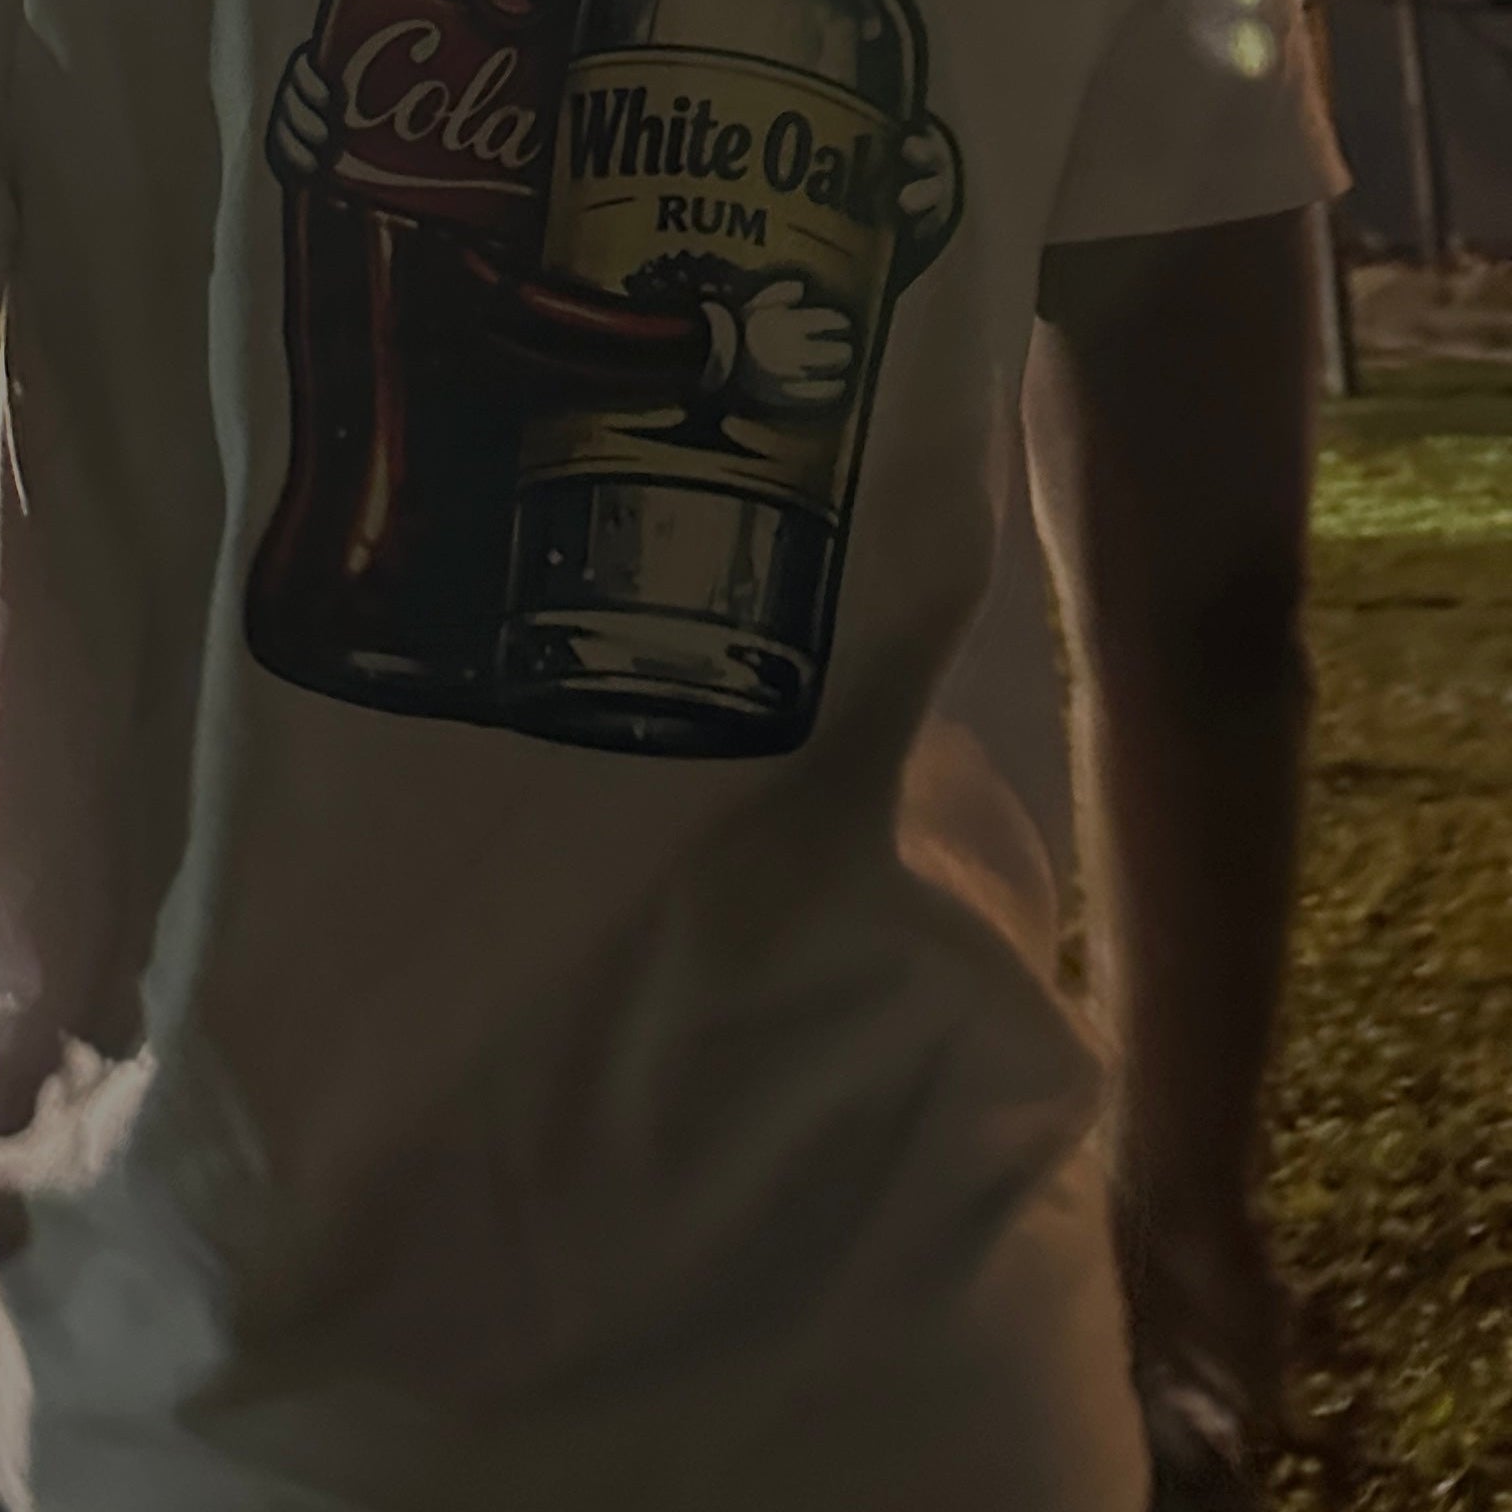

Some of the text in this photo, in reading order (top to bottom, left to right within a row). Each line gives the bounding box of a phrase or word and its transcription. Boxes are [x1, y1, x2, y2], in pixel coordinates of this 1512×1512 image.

[342, 18, 543, 169] Cola
[569, 85, 752, 181] White
[656, 195, 768, 248] RUM
